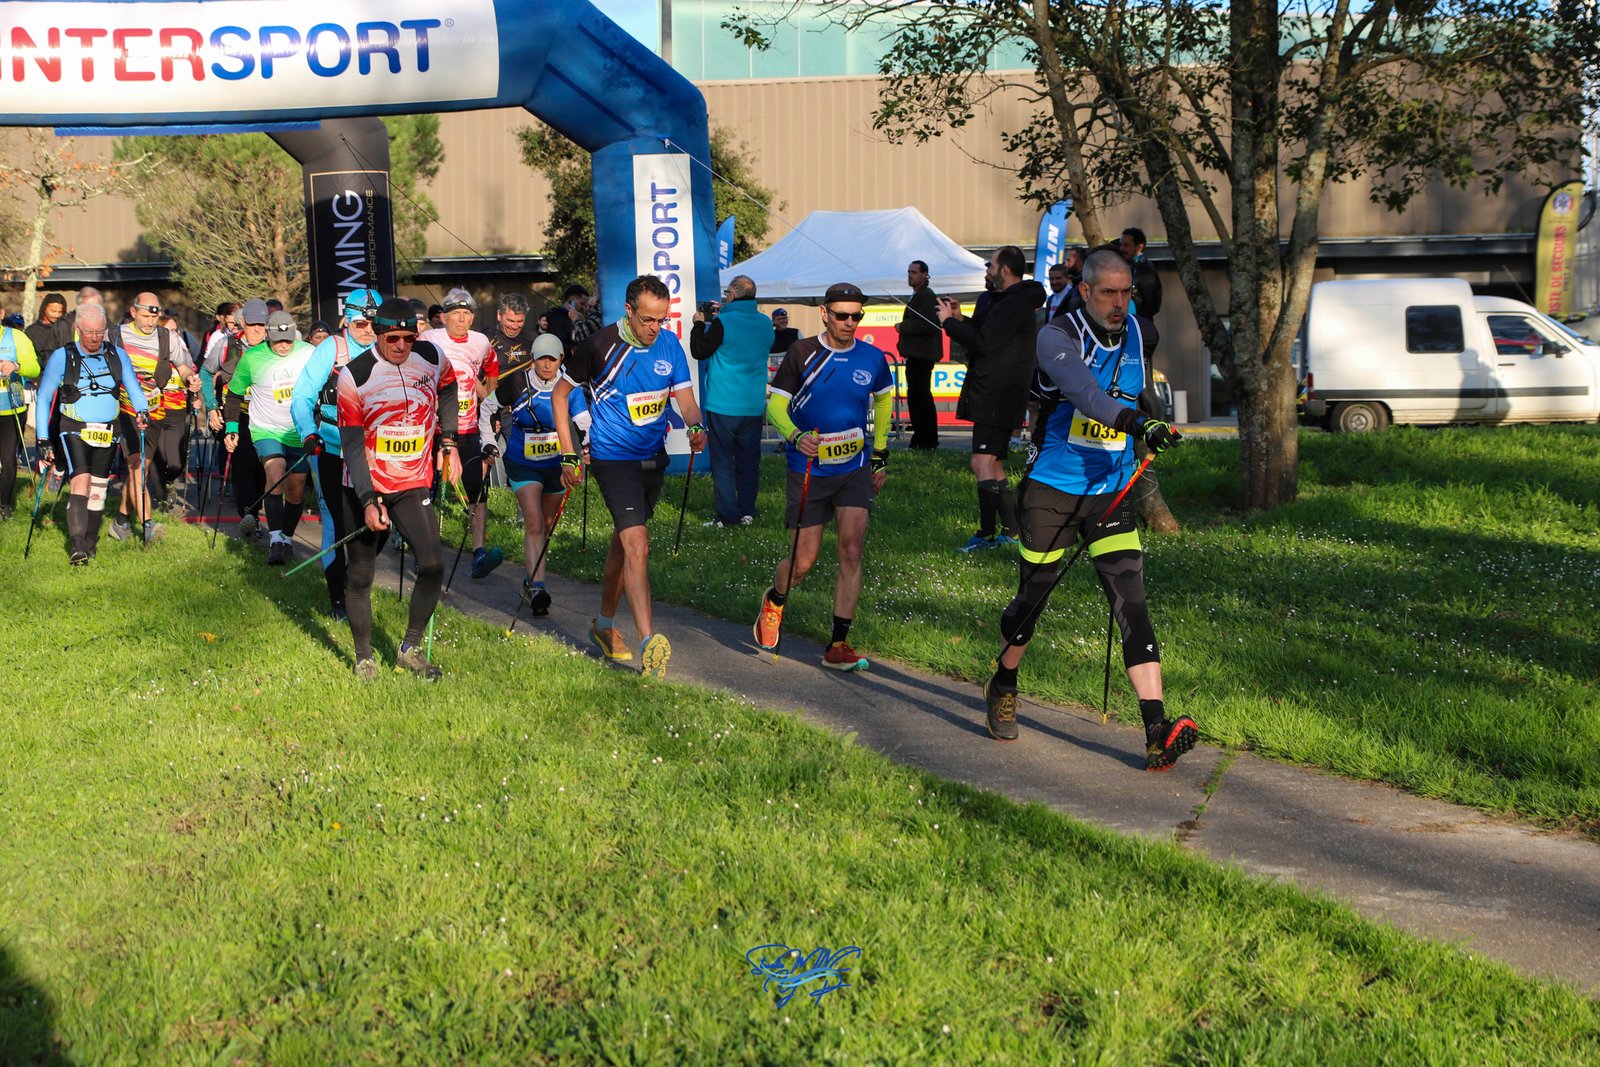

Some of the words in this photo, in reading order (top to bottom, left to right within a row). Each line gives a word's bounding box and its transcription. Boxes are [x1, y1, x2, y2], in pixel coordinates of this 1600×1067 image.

[0, 18, 441, 82] NTERSPORT
[366, 189, 377, 281] PERFORMANCE
[1552, 225, 1566, 272] SECOURS
[1551, 276, 1562, 288] DE
[459, 401, 468, 410] 25
[635, 402, 663, 417] 1036
[87, 431, 108, 442] 1040
[385, 439, 416, 453] 1001
[530, 442, 557, 454] 1034
[825, 442, 858, 457] 1035
